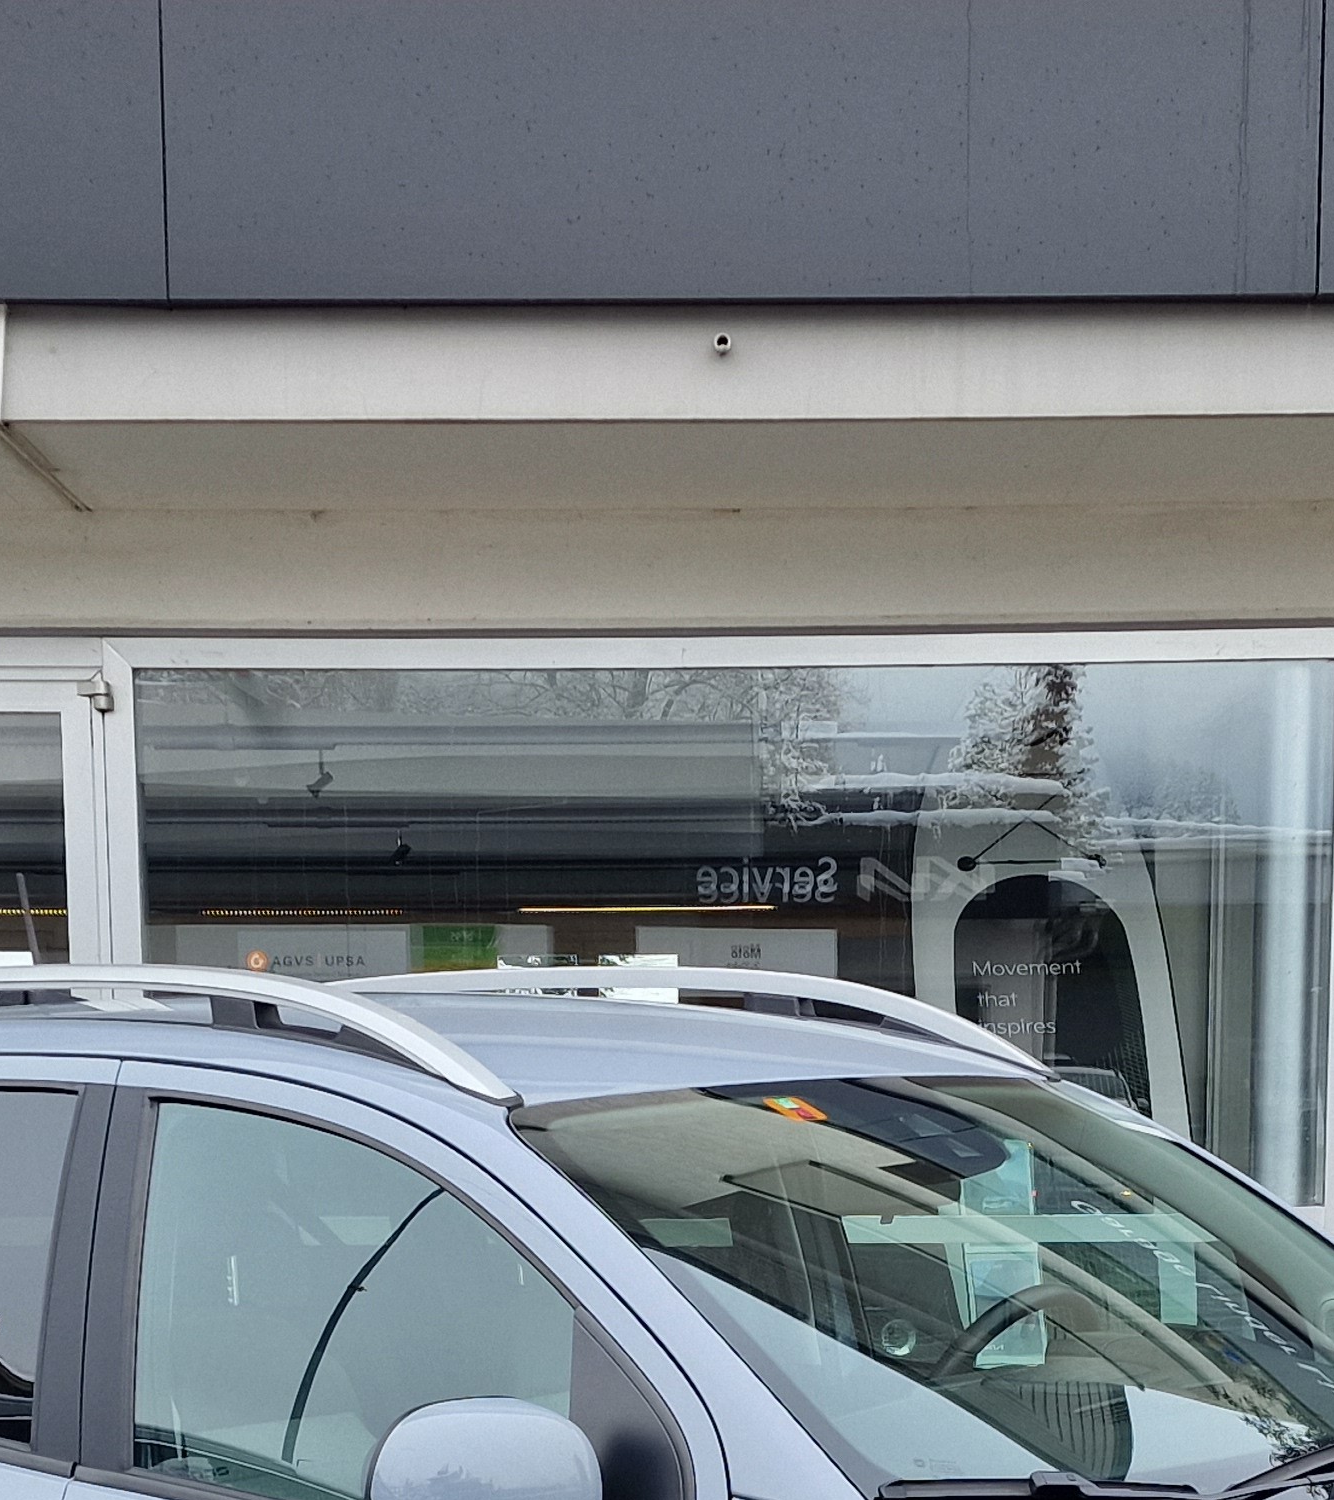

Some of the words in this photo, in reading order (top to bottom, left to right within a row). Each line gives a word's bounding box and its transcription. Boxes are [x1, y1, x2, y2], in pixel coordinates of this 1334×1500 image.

[272, 955, 315, 967] AGVS
[324, 955, 366, 967] UPSA
[972, 959, 1082, 977] Movement
[977, 990, 1018, 1008] that
